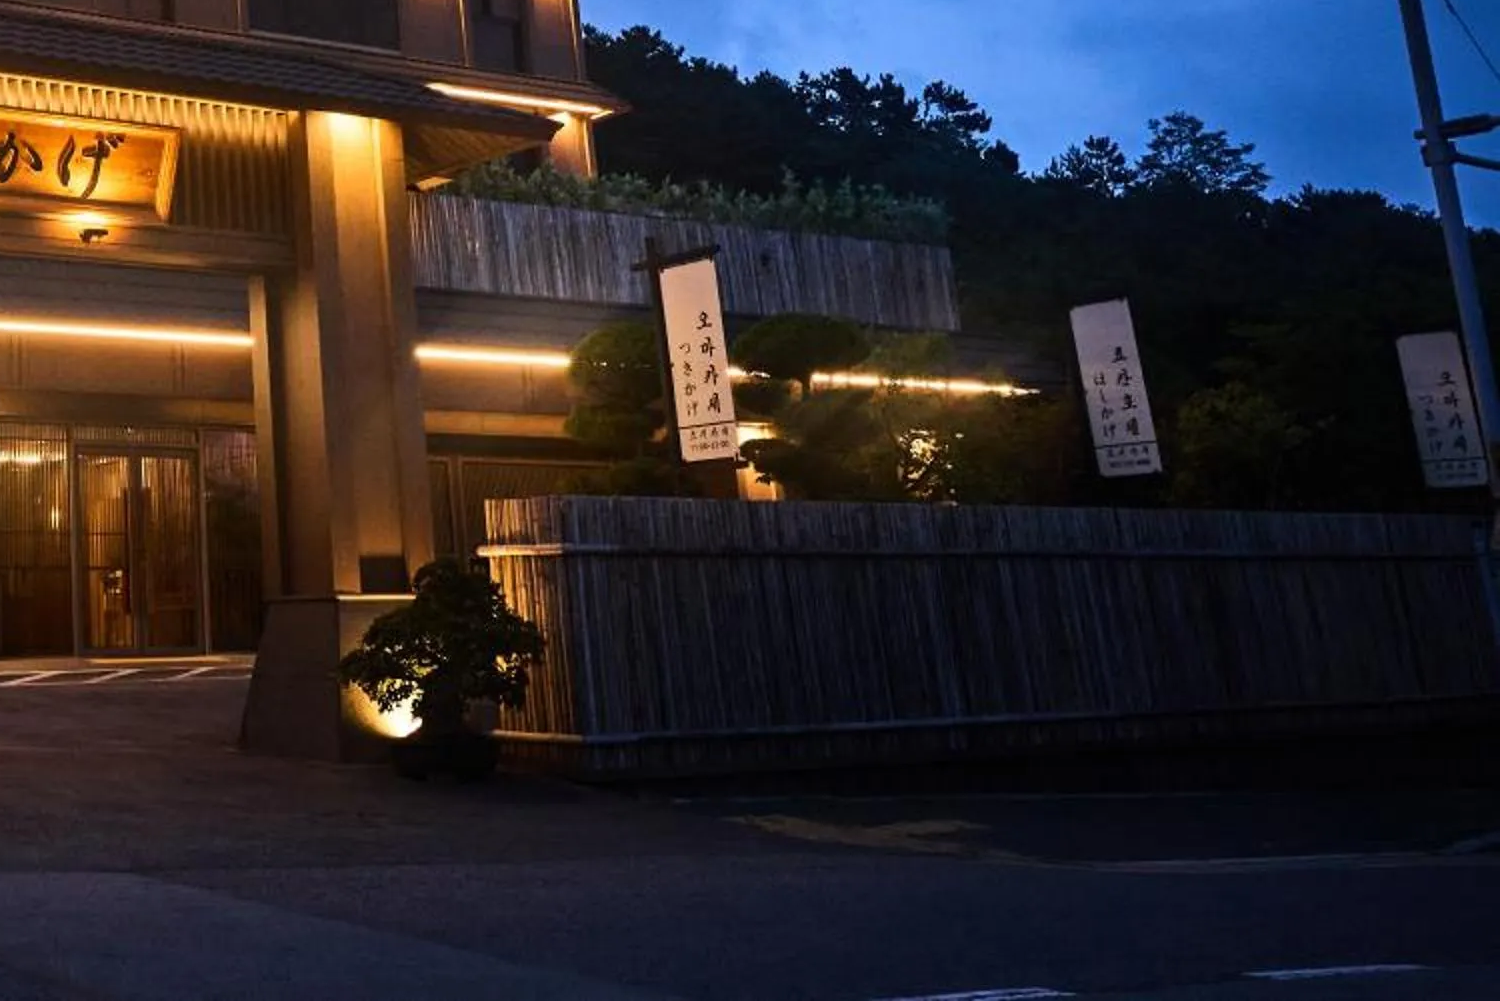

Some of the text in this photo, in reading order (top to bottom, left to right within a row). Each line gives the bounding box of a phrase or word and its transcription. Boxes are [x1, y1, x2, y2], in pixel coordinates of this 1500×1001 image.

[679, 342, 698, 417] つきかげ
[696, 311, 721, 414] 오마카세
